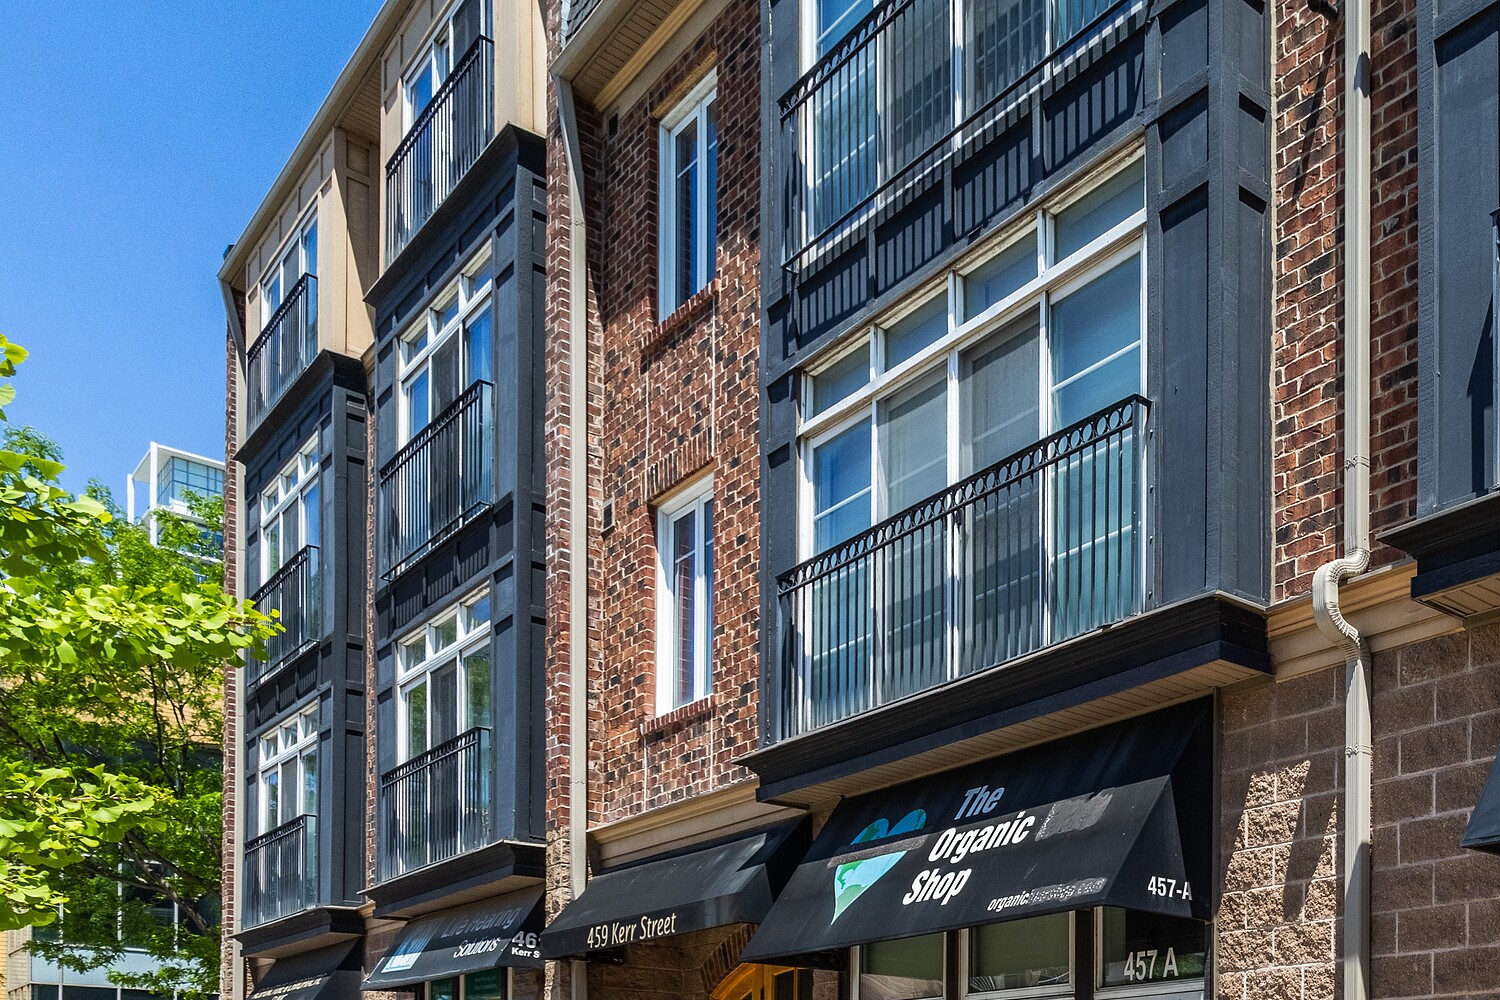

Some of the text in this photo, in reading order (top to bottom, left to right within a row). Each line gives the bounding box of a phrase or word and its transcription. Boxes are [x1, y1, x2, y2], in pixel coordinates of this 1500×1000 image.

[953, 785, 1005, 820] The
[928, 811, 1036, 864] Organic
[902, 867, 973, 906] Shop
[1147, 875, 1193, 901] 457-A
[441, 916, 467, 939] Life
[511, 930, 541, 948] 46
[587, 912, 677, 949] 459 Kerr Street
[453, 937, 501, 959] Solutions
[511, 946, 542, 959] Kerr S
[1124, 947, 1179, 981] 457 A
